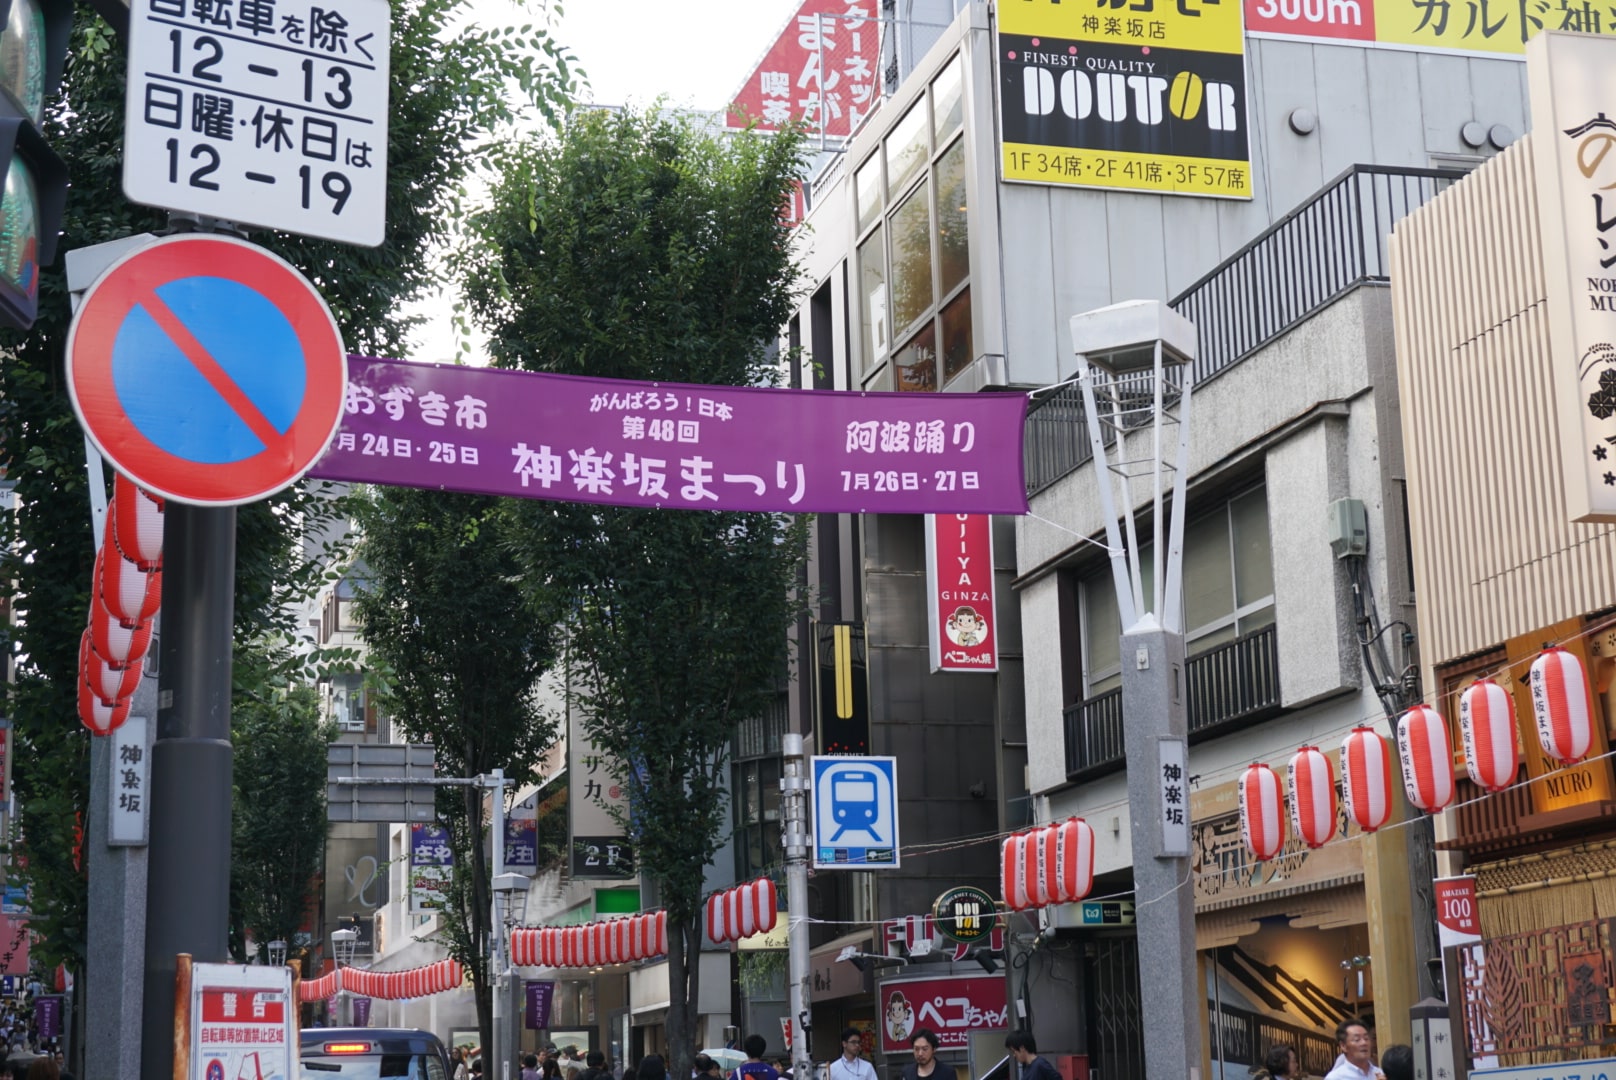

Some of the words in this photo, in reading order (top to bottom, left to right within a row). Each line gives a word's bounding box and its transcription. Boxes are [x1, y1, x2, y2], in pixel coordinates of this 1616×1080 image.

[1081, 14, 1166, 39] 神楽坂店
[1411, 0, 1616, 45] カルド神
[797, 13, 842, 128] まんが
[1023, 51, 1078, 67] FINEST
[1086, 57, 1156, 73] QUALITY
[760, 71, 791, 126] 喫茶
[1023, 66, 1237, 131] DOUTOR
[144, 82, 373, 168] 日曜・休日は
[622, 414, 700, 443] 第48回
[846, 420, 975, 454] 阿波踊り
[511, 442, 806, 505] 神楽坂まつり
[841, 470, 979, 492] 7月26日・27日
[941, 590, 990, 601] GINZA
[120, 744, 142, 814] 神楽坂
[1163, 763, 1184, 826] 神楽坂
[1546, 769, 1593, 799] MURO
[585, 845, 621, 866] 2F
[1443, 898, 1471, 919] 100
